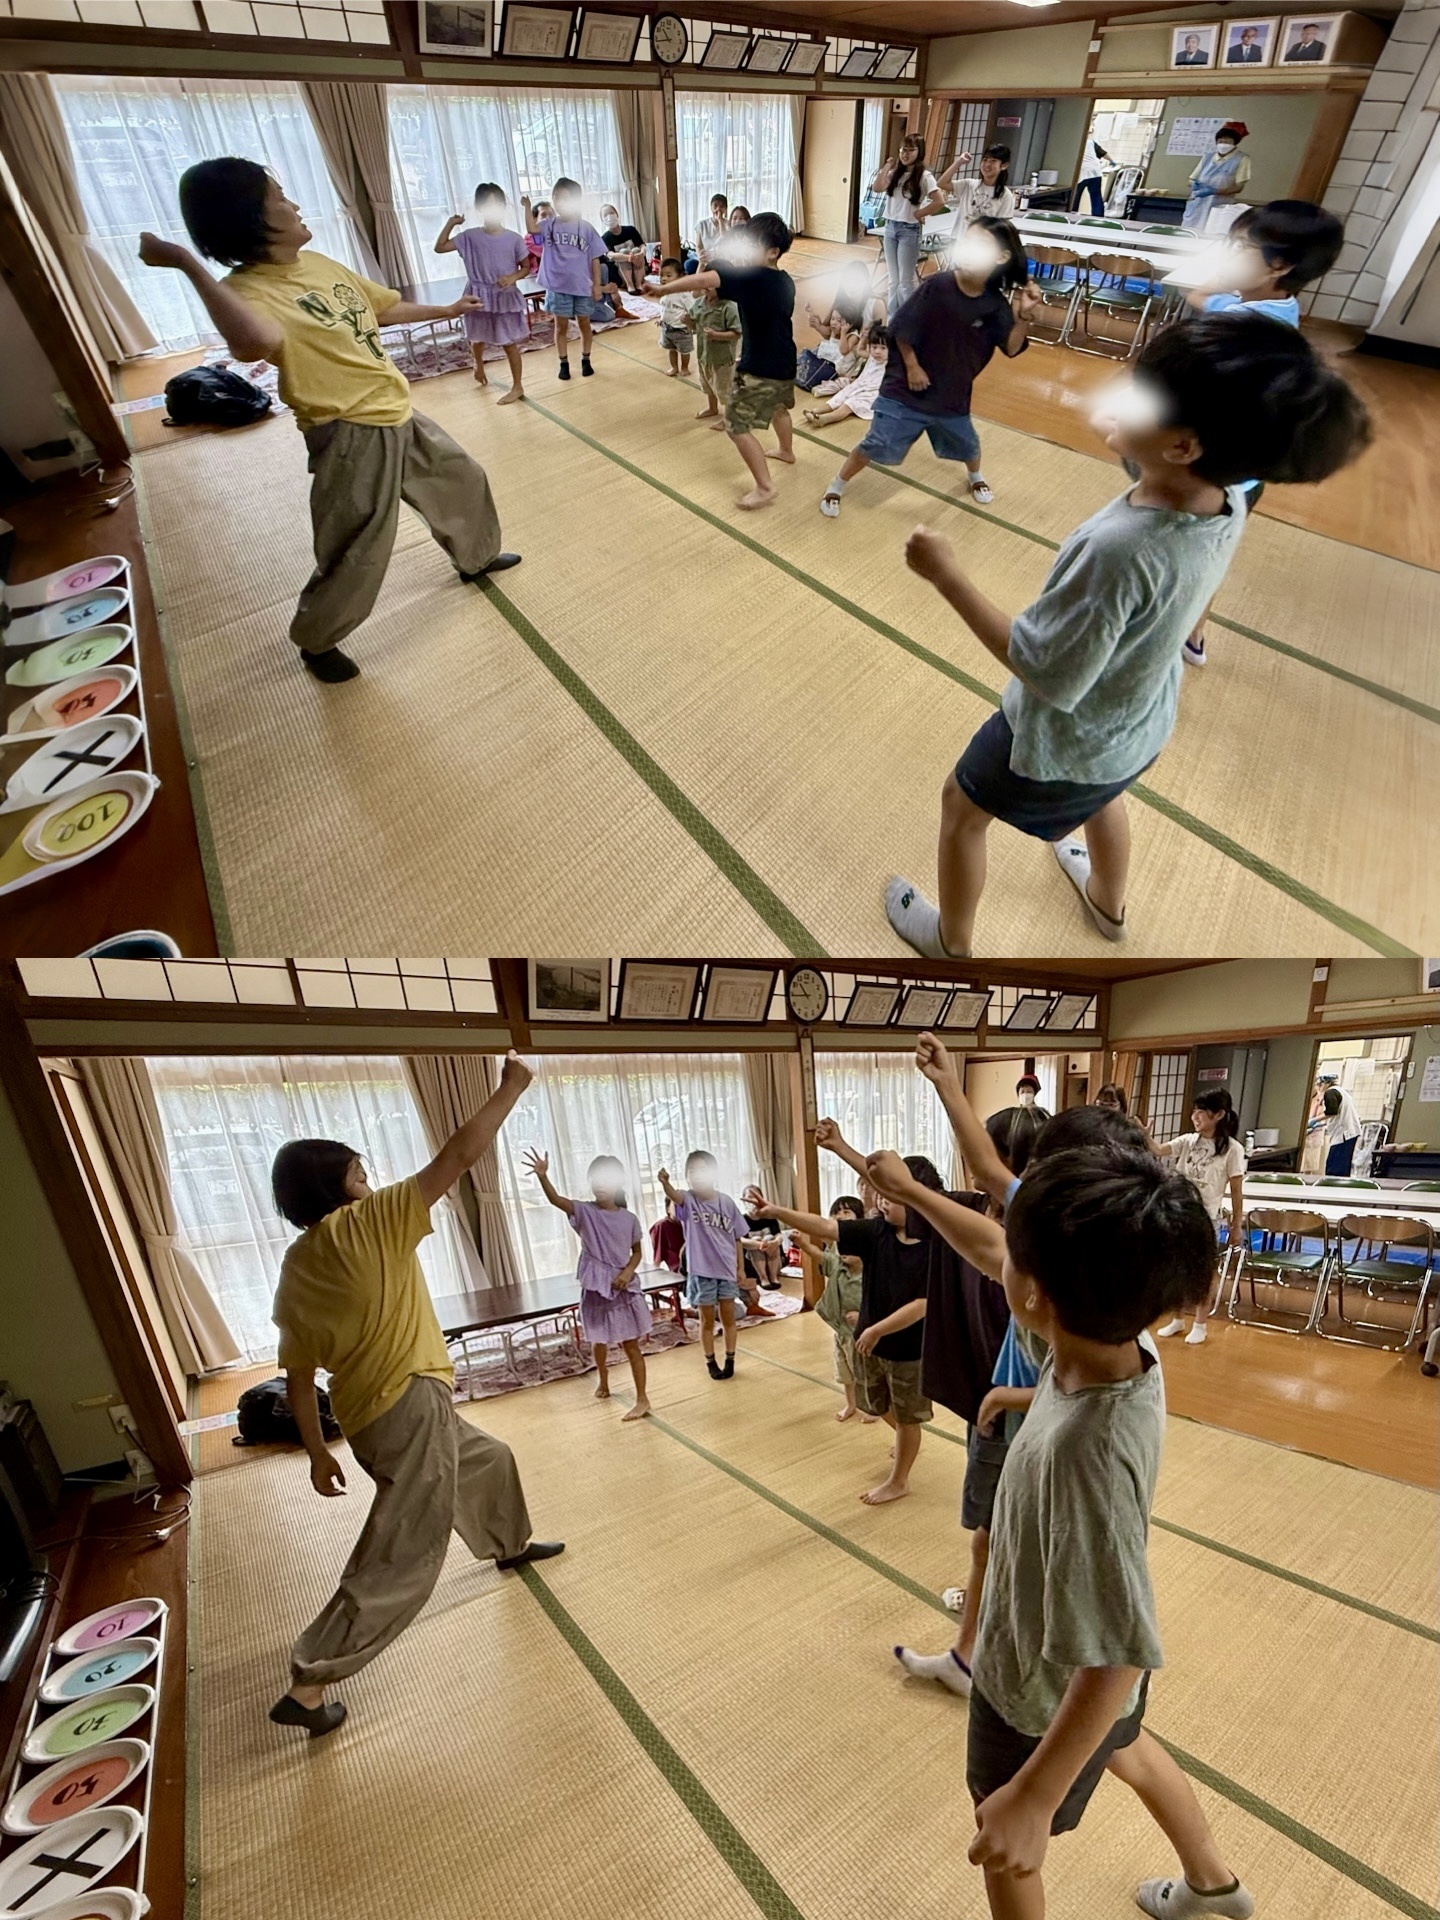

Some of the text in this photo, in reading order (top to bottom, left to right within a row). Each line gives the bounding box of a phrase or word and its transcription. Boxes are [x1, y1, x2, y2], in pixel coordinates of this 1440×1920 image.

[69, 572, 94, 588] 10
[58, 801, 116, 842] 100
[97, 1615, 127, 1637] 10
[85, 1661, 121, 1683] 20
[73, 1711, 118, 1735] 30
[52, 1771, 104, 1805] 50
